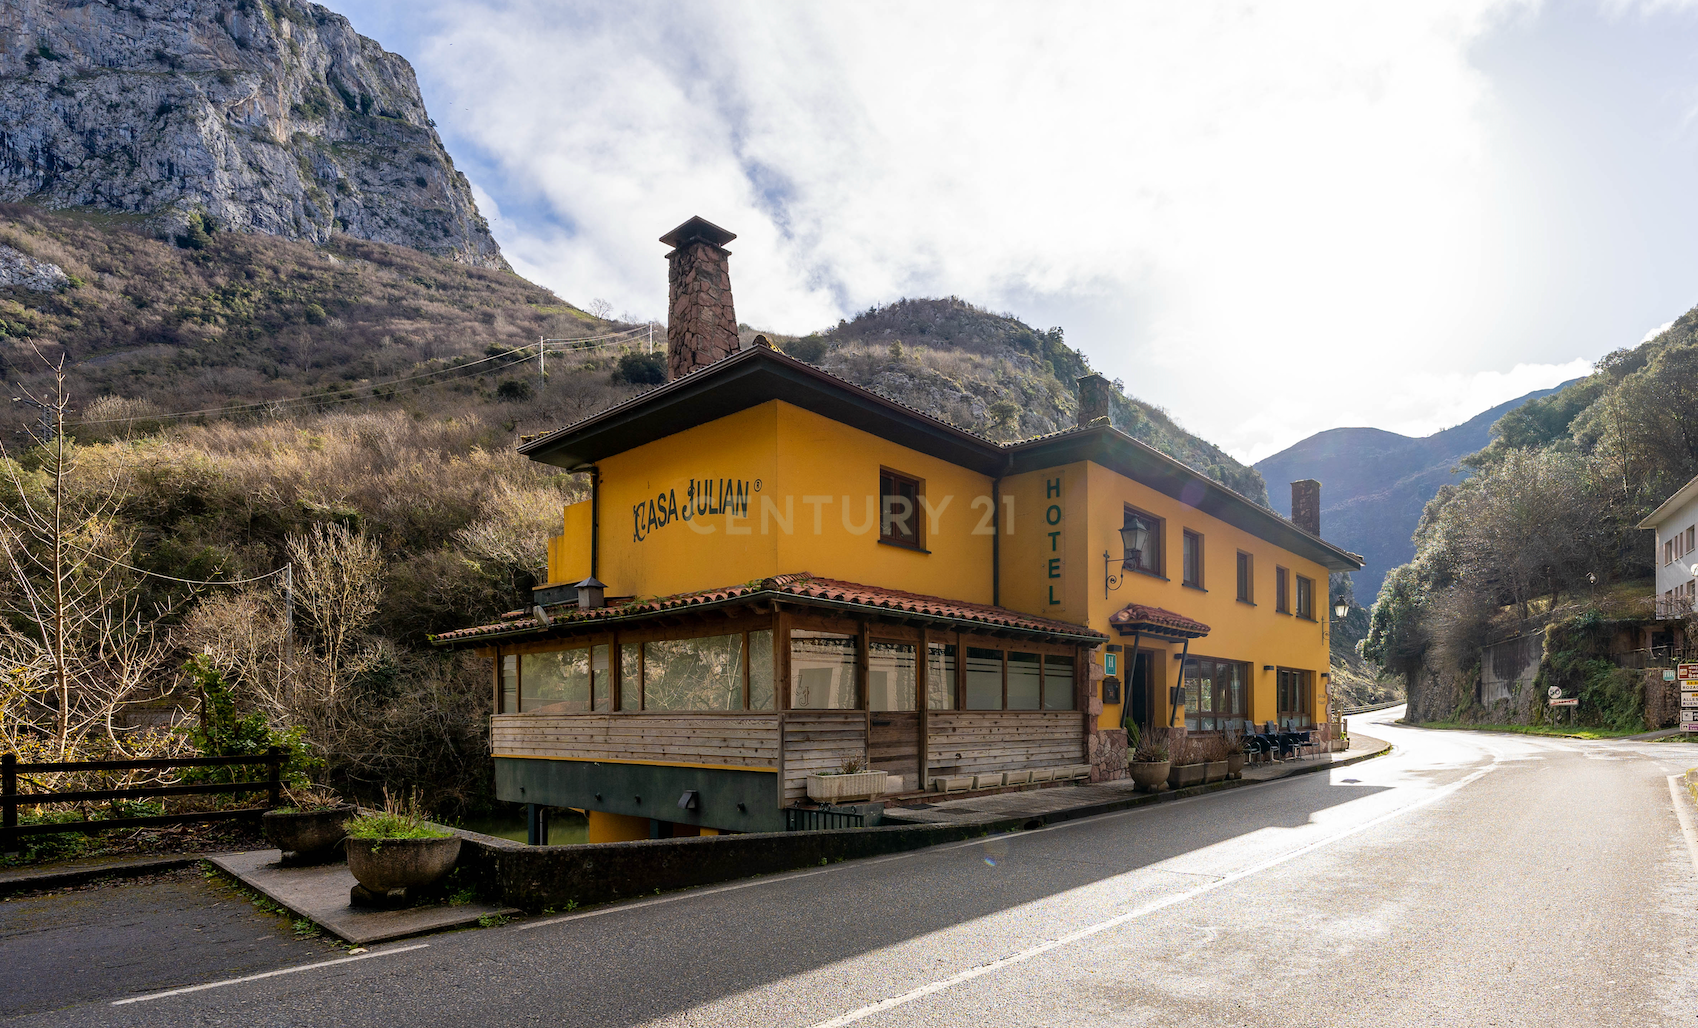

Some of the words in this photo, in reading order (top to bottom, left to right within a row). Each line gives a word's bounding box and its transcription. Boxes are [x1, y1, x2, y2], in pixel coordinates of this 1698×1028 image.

[633, 488, 679, 543] CASA
[682, 478, 750, 521] JULIAN
[1046, 478, 1061, 605] HOTEL
[1108, 656, 1114, 667] H
